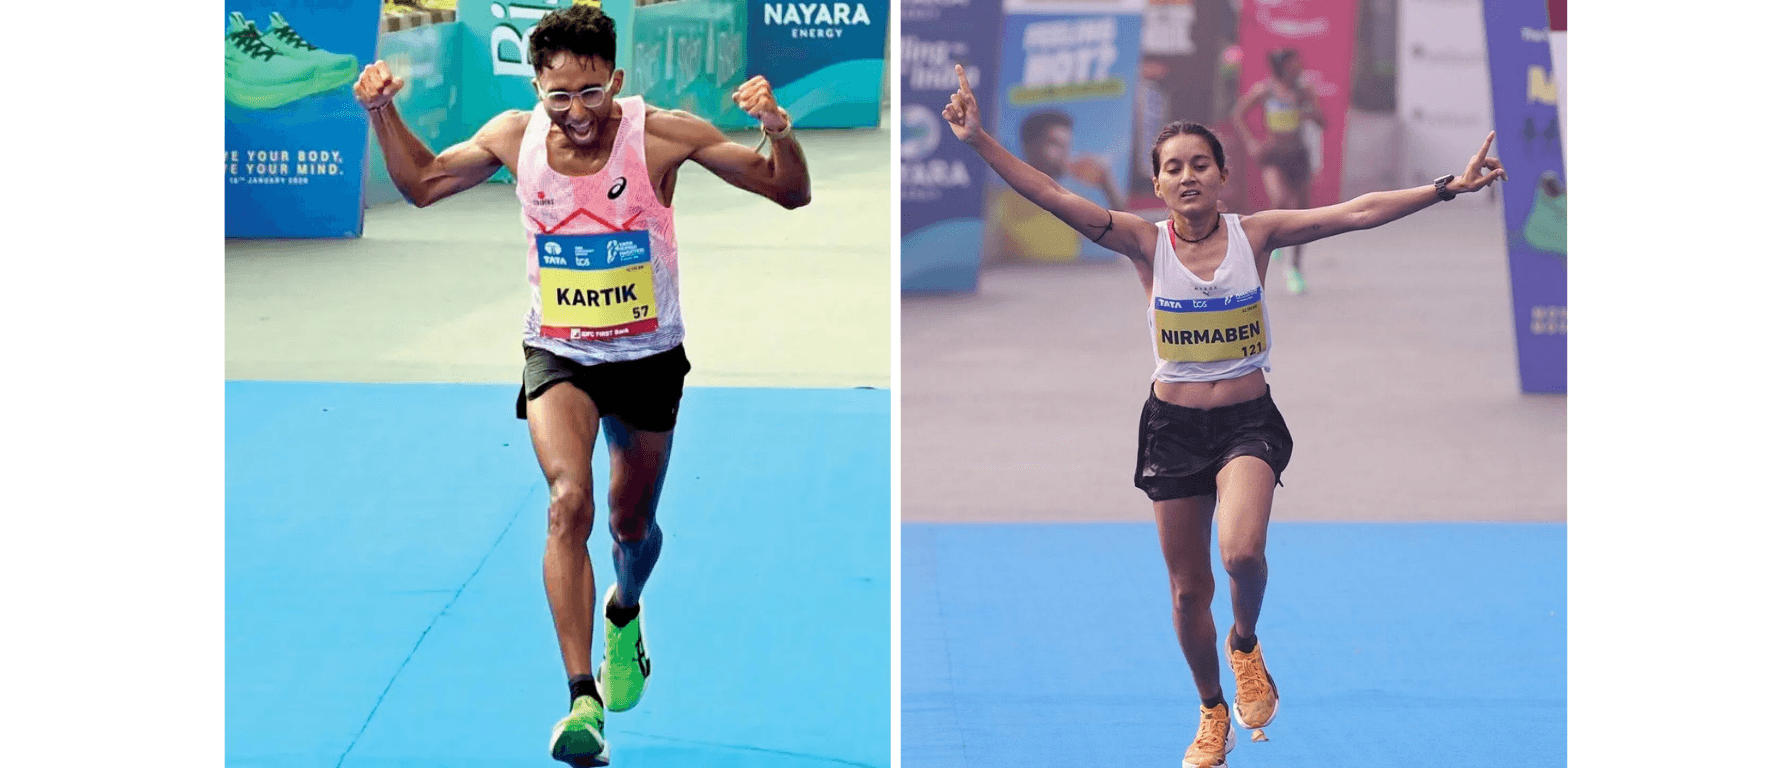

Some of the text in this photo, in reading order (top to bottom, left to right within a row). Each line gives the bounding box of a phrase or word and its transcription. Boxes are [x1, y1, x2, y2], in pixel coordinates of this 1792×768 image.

[764, 3, 871, 25] NAYARA
[791, 28, 843, 38] ENERGY
[247, 150, 289, 162] YOUR
[298, 150, 343, 163] BODY,
[246, 163, 288, 174] YOUR
[297, 163, 343, 175] MIND.
[901, 160, 971, 187] ARA
[543, 256, 567, 266] TATA
[556, 283, 637, 307] KARTIK
[1158, 298, 1182, 309] TATA
[632, 305, 649, 320] 57
[614, 327, 629, 336] Bank
[1161, 320, 1261, 345] NIRMABEN
[1241, 342, 1263, 357] 121
